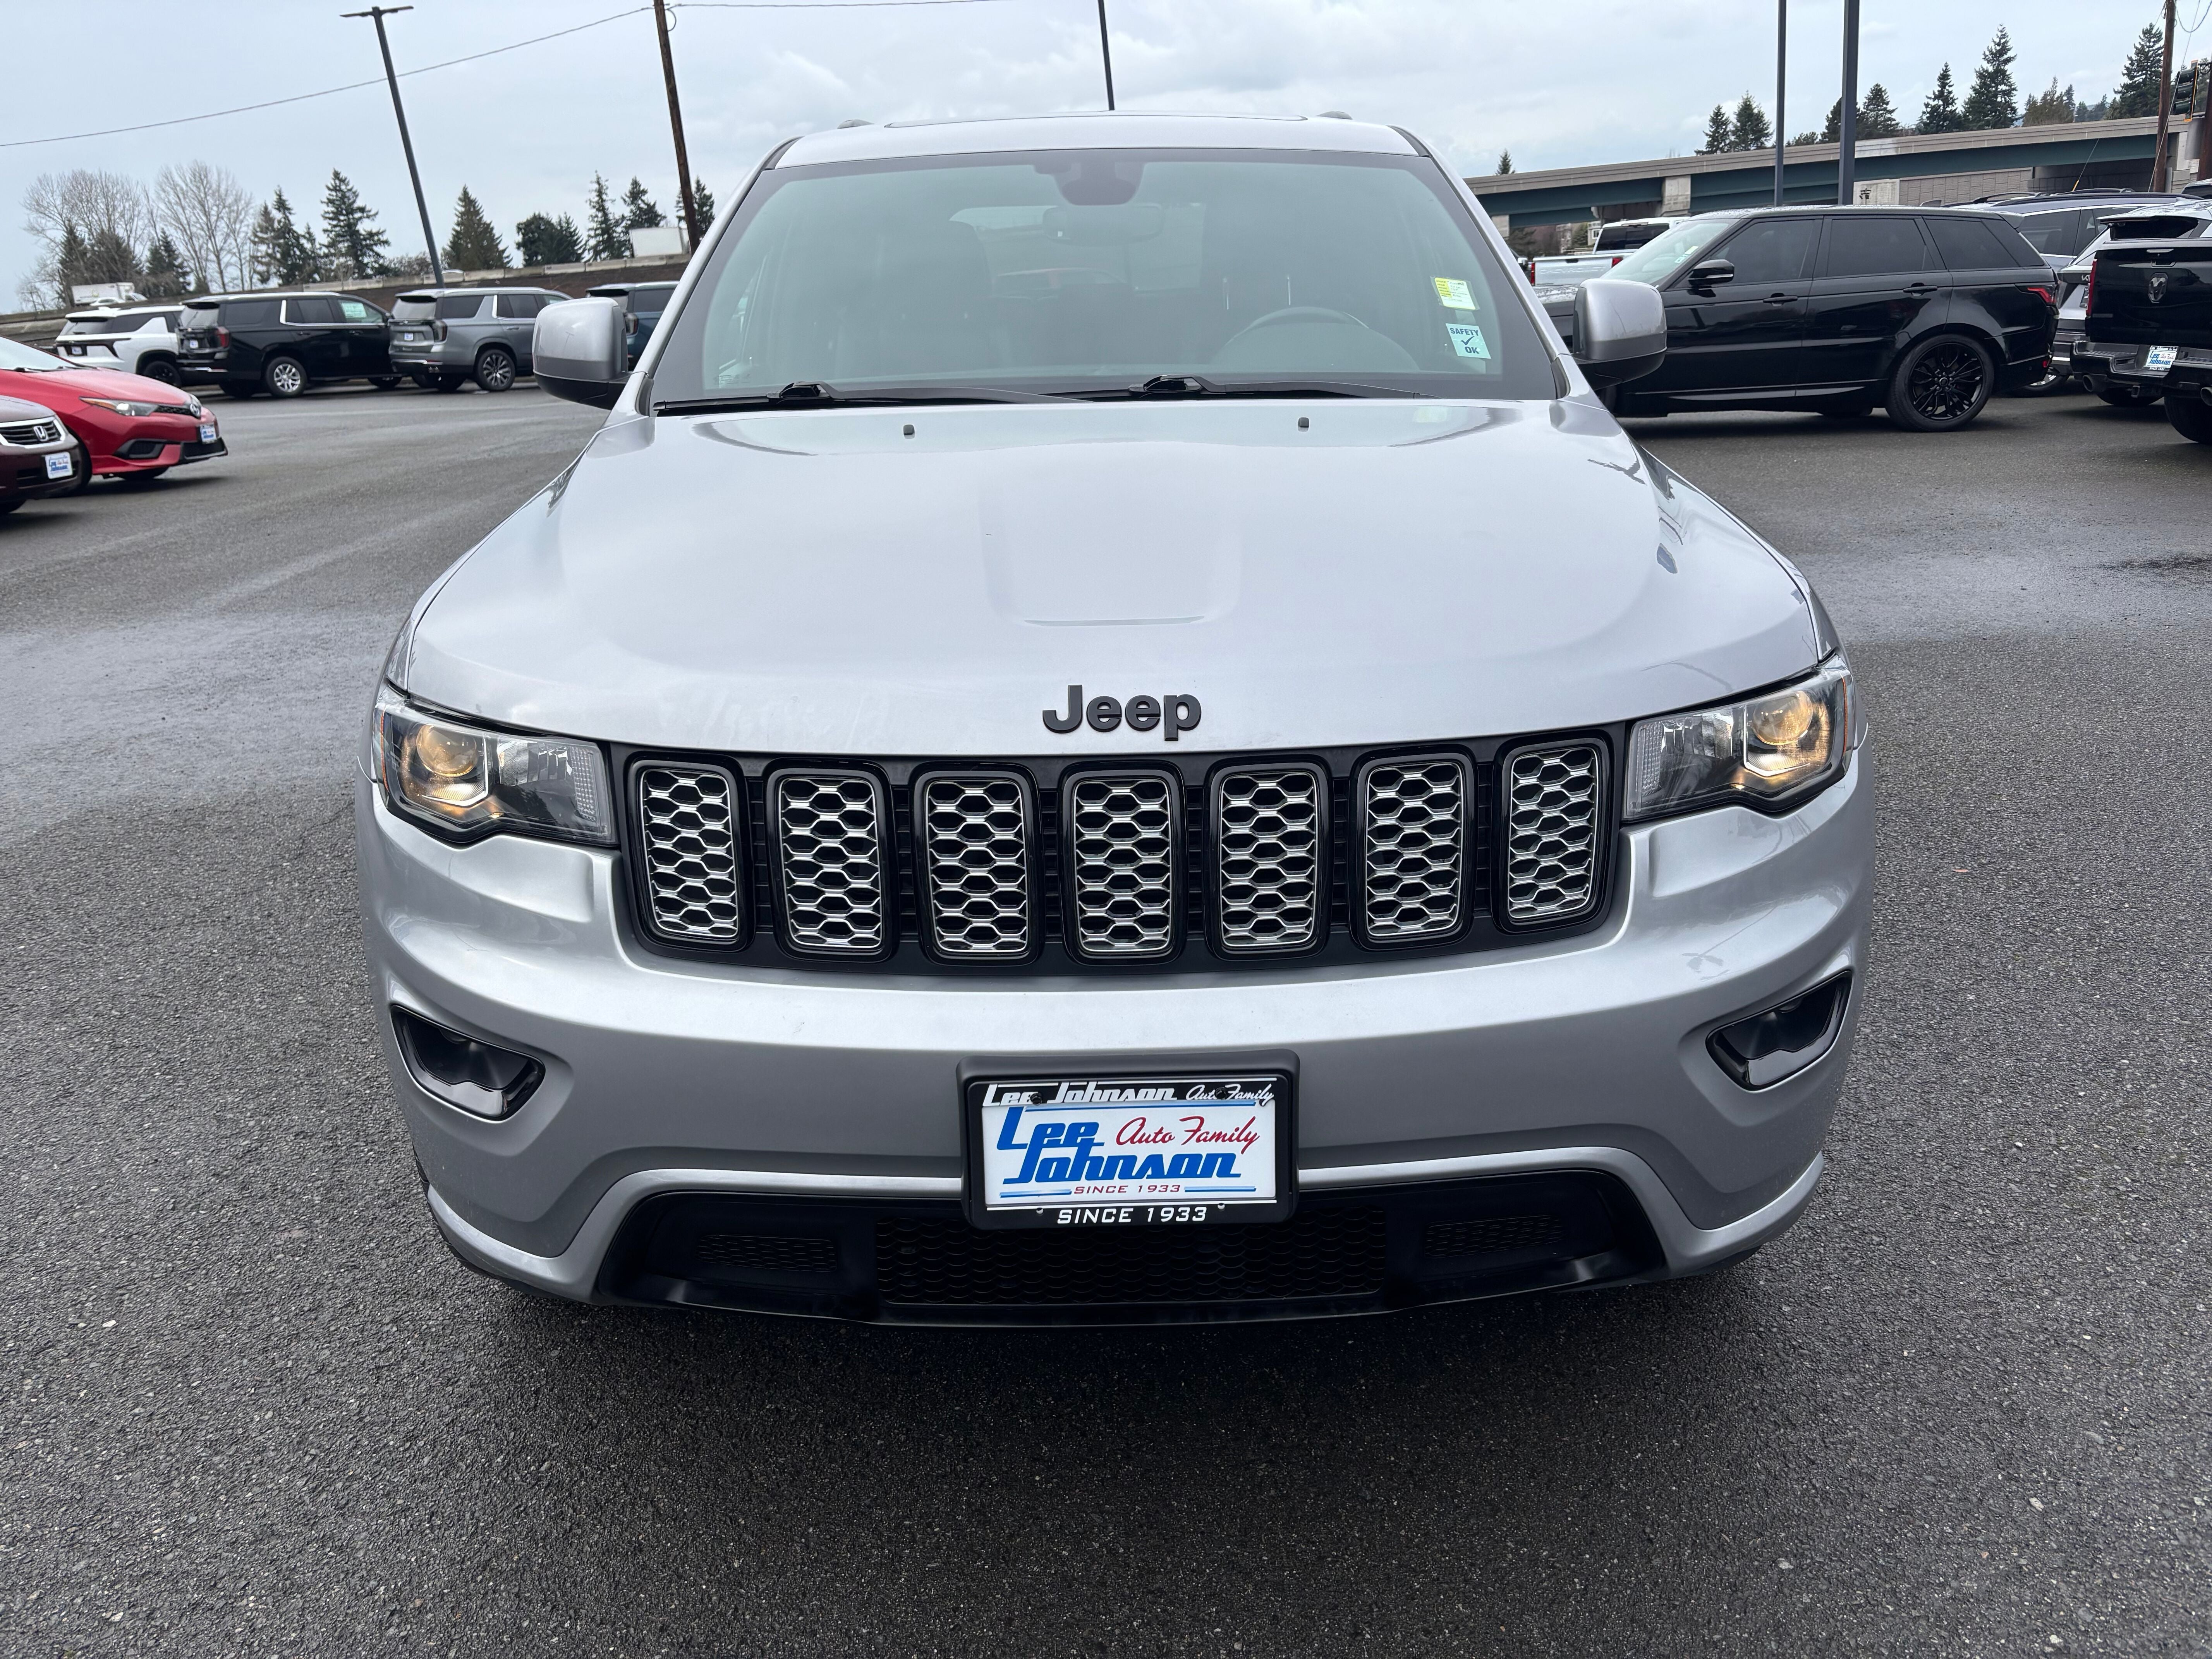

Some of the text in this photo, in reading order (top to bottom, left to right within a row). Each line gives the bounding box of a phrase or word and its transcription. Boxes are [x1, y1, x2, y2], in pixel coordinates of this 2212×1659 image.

[1449, 328, 1479, 336] SAFETY
[1042, 684, 1202, 741] Jeep
[1047, 1081, 1177, 1104] Johnson
[1186, 1084, 1221, 1100] Aut
[1225, 1083, 1274, 1106] Family
[997, 1106, 1104, 1150] Lee
[1116, 1116, 1260, 1155] Auto Family
[1002, 1138, 1242, 1184] Johnson
[1074, 1184, 1181, 1194] SINCE 1933
[1057, 1206, 1207, 1224] SINCE 1933
